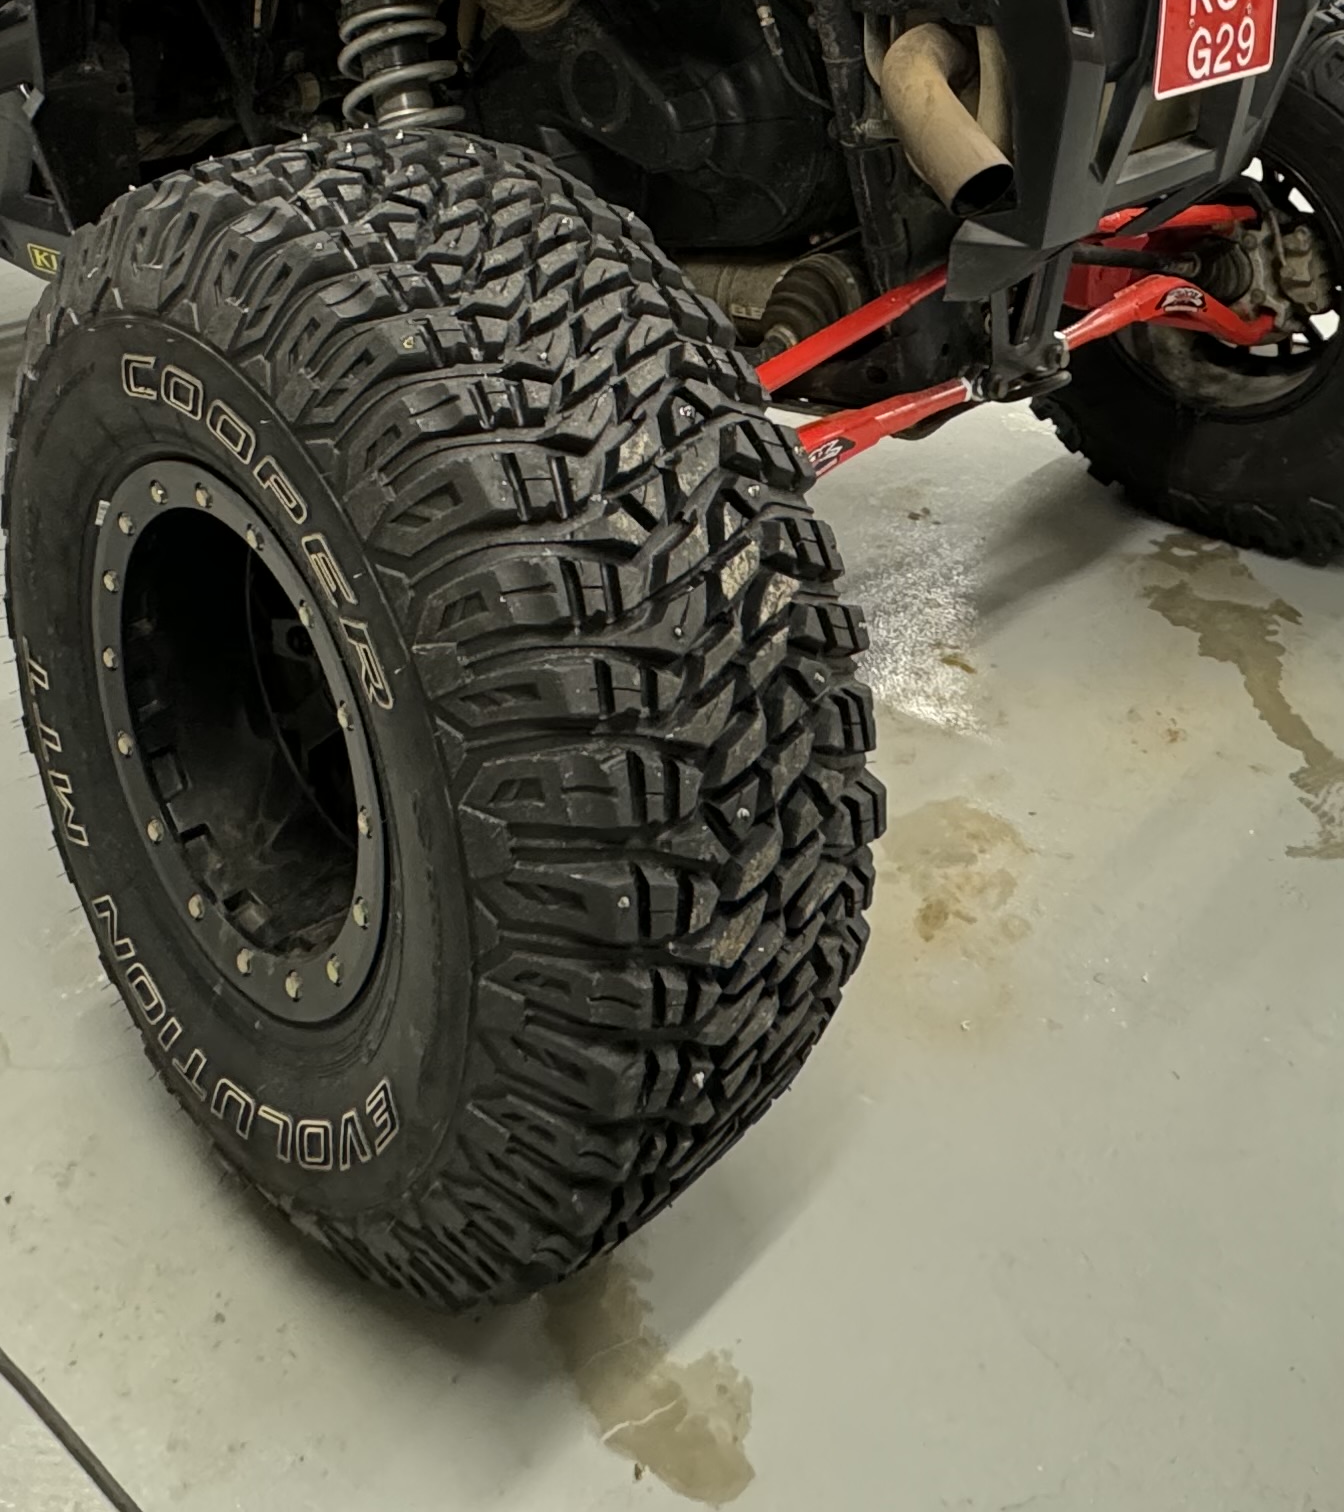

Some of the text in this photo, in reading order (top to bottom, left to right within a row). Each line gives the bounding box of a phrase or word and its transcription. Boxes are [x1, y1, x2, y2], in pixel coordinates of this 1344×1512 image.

[1187, 15, 1256, 80] G29
[120, 352, 394, 710] COOPER
[92, 894, 400, 1172] EVOLUTION
